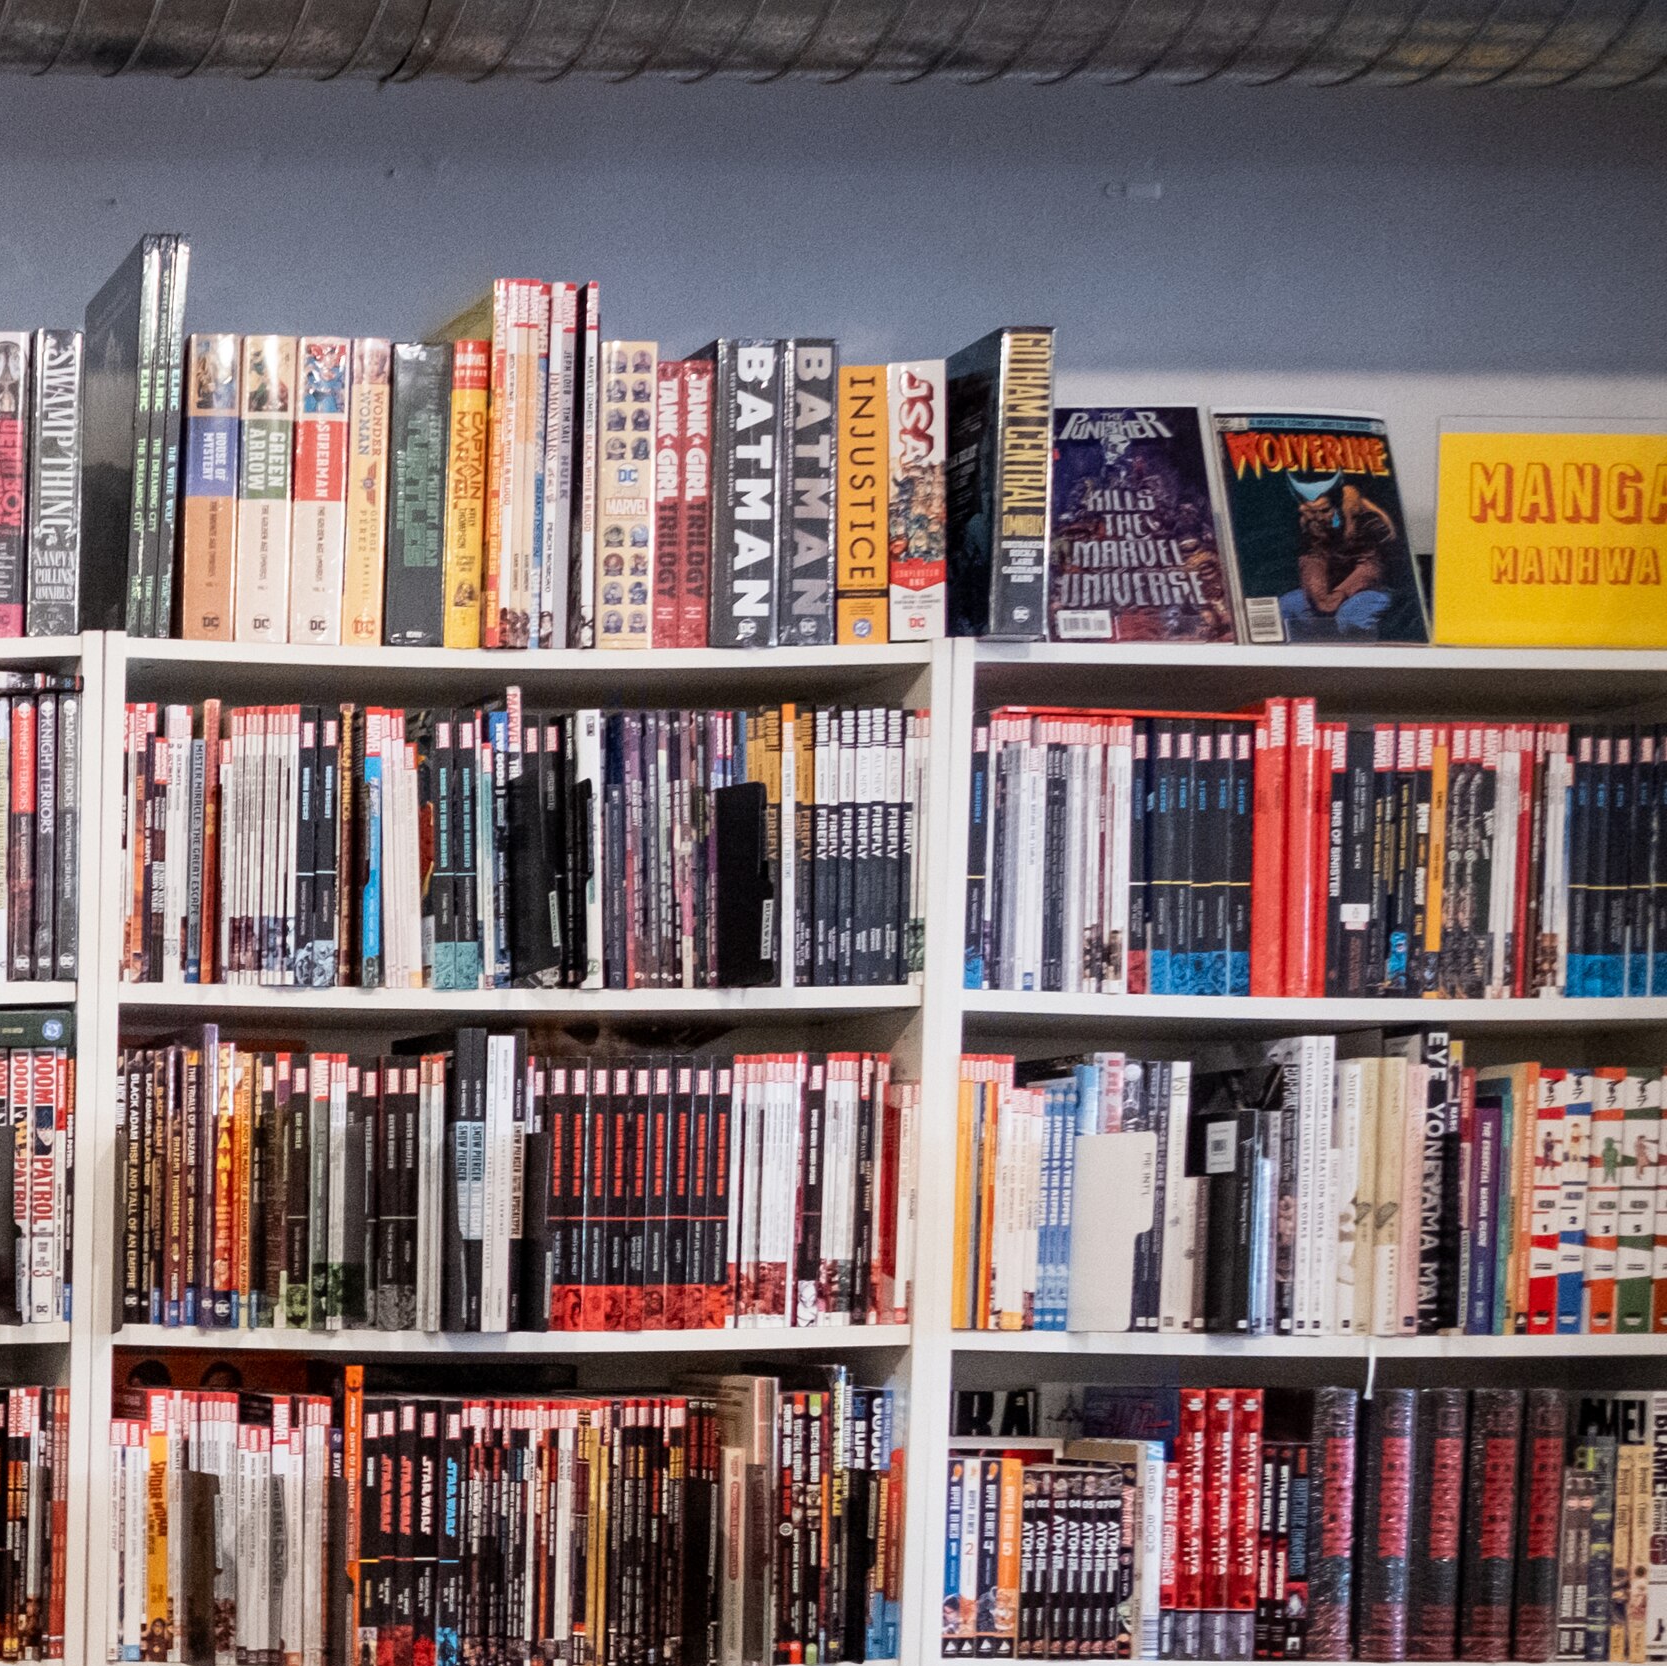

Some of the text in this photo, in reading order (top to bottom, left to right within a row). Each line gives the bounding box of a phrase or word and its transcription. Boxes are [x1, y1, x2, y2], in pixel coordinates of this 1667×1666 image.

[685, 377, 709, 436] TANK
[898, 370, 936, 466] JSA
[1004, 333, 1052, 511] GOTHAM CENTRAL
[1059, 411, 1174, 442] PUNISHER
[39, 348, 76, 536] SWAMP THING
[247, 426, 264, 491] ARROW
[267, 430, 286, 490] GREEN
[1223, 429, 1391, 480] WOLVERINE
[684, 450, 707, 502] GIRL
[731, 346, 777, 618] BATMAN
[790, 346, 833, 617] BATMAN
[849, 374, 876, 580] INJUSTICE
[1469, 461, 1667, 525] MANGA
[1071, 538, 1186, 569] MARVEL
[1490, 545, 1661, 584] MANHWA
[1427, 1032, 1447, 1082] EYE
[33, 1055, 54, 1225] DOOM PATROL
